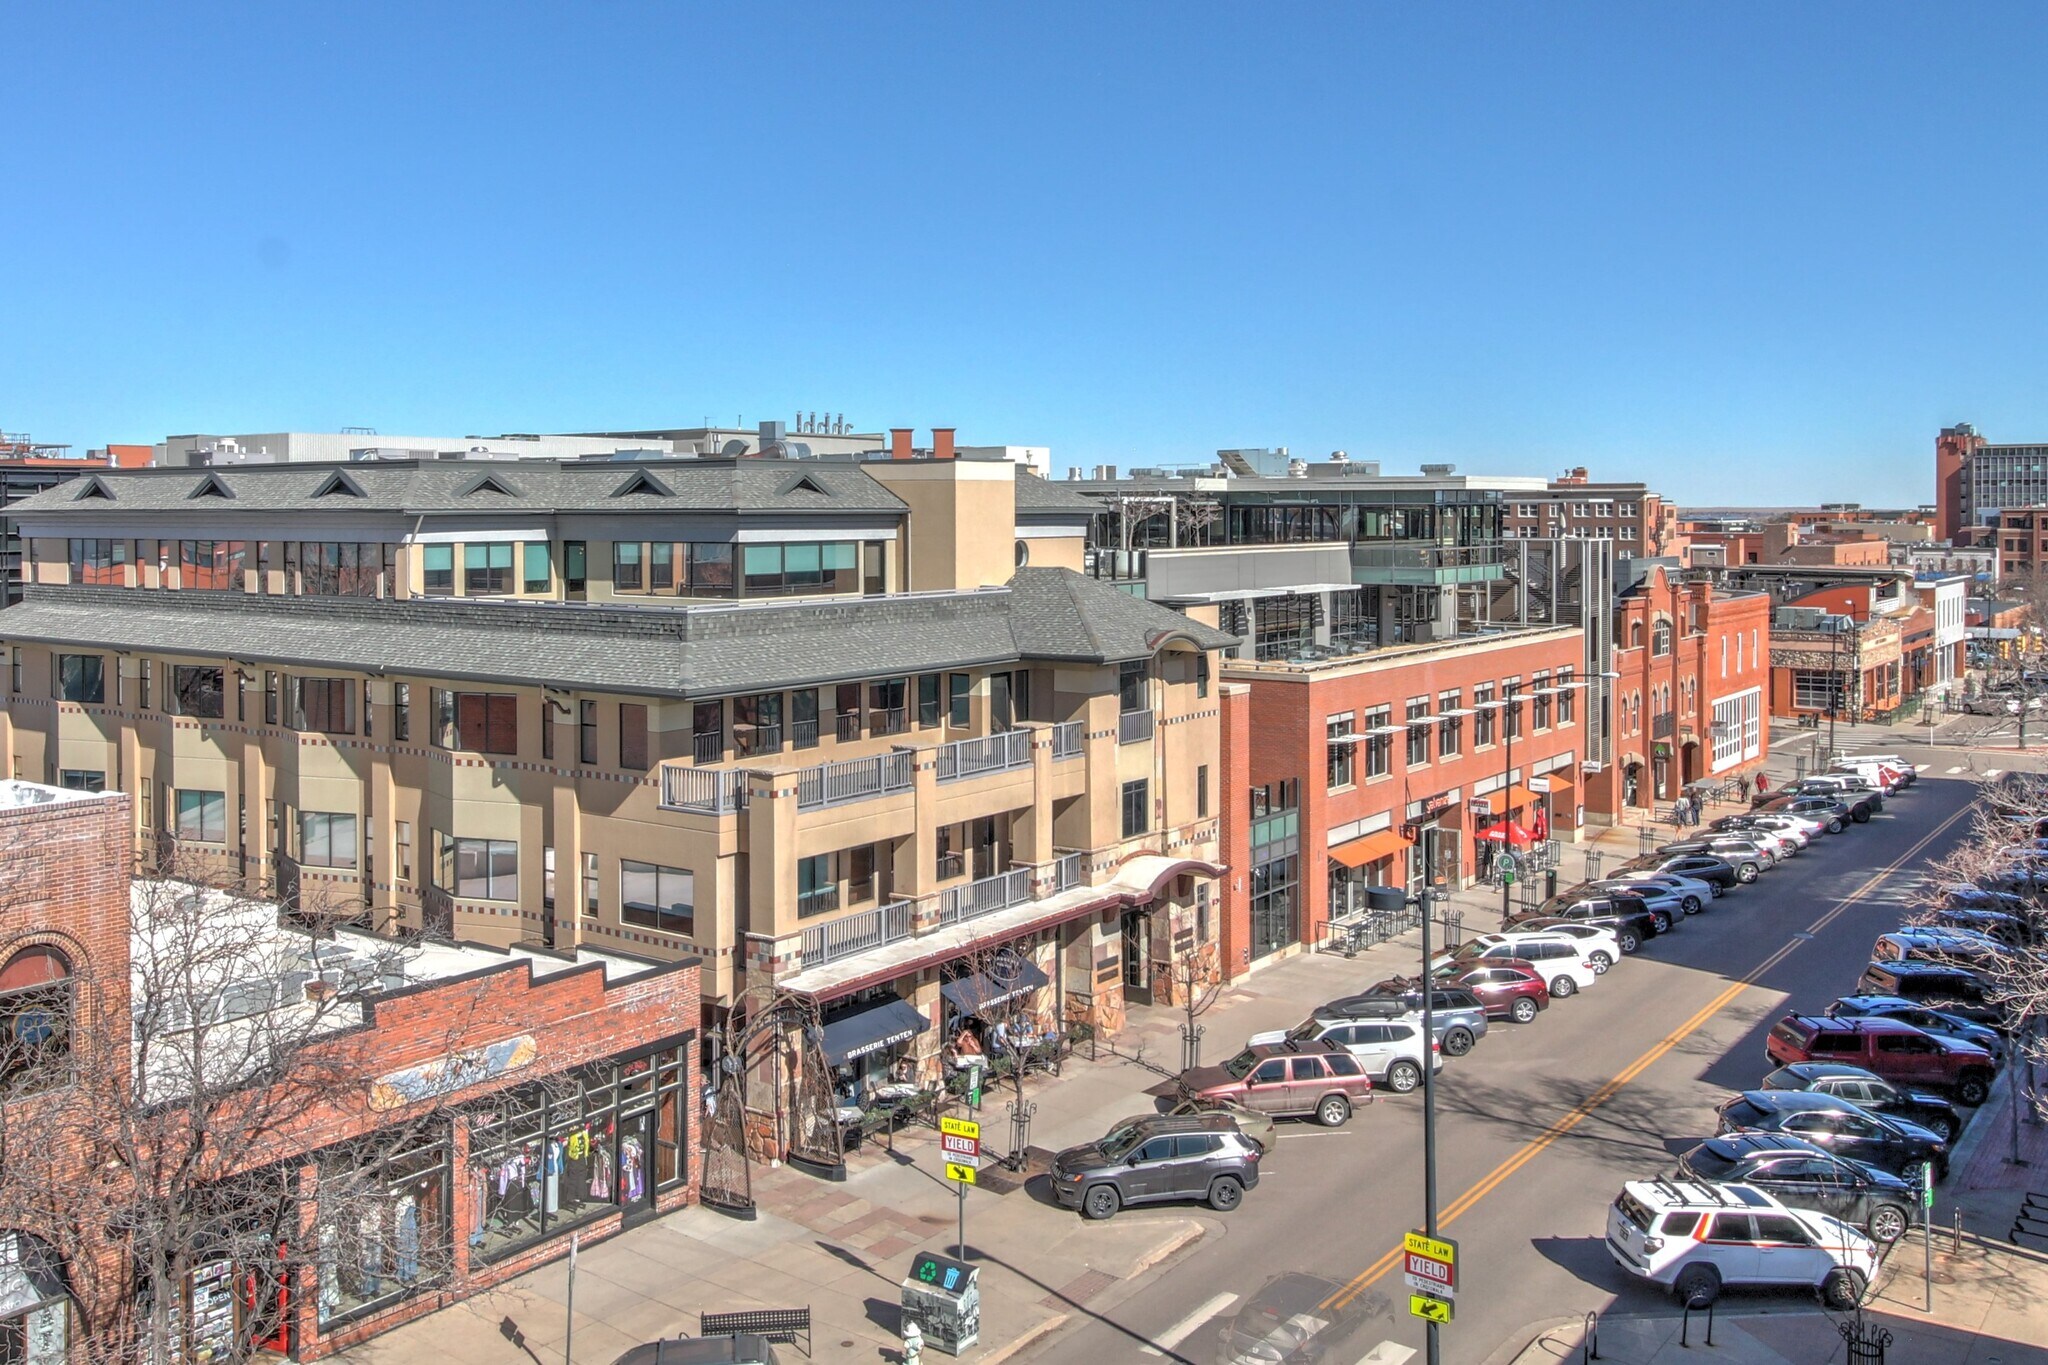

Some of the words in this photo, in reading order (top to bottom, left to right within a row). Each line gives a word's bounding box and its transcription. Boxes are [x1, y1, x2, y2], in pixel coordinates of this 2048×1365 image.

[847, 1039, 885, 1059] BRASSERIE
[886, 1029, 914, 1045] TENTEN
[945, 1122, 960, 1131] STATE
[947, 1137, 974, 1151] YIELD
[1409, 1239, 1430, 1252] STATE
[1433, 1244, 1449, 1257] LAW
[1412, 1257, 1446, 1278] YIELD
[207, 1291, 231, 1306] OPEN
